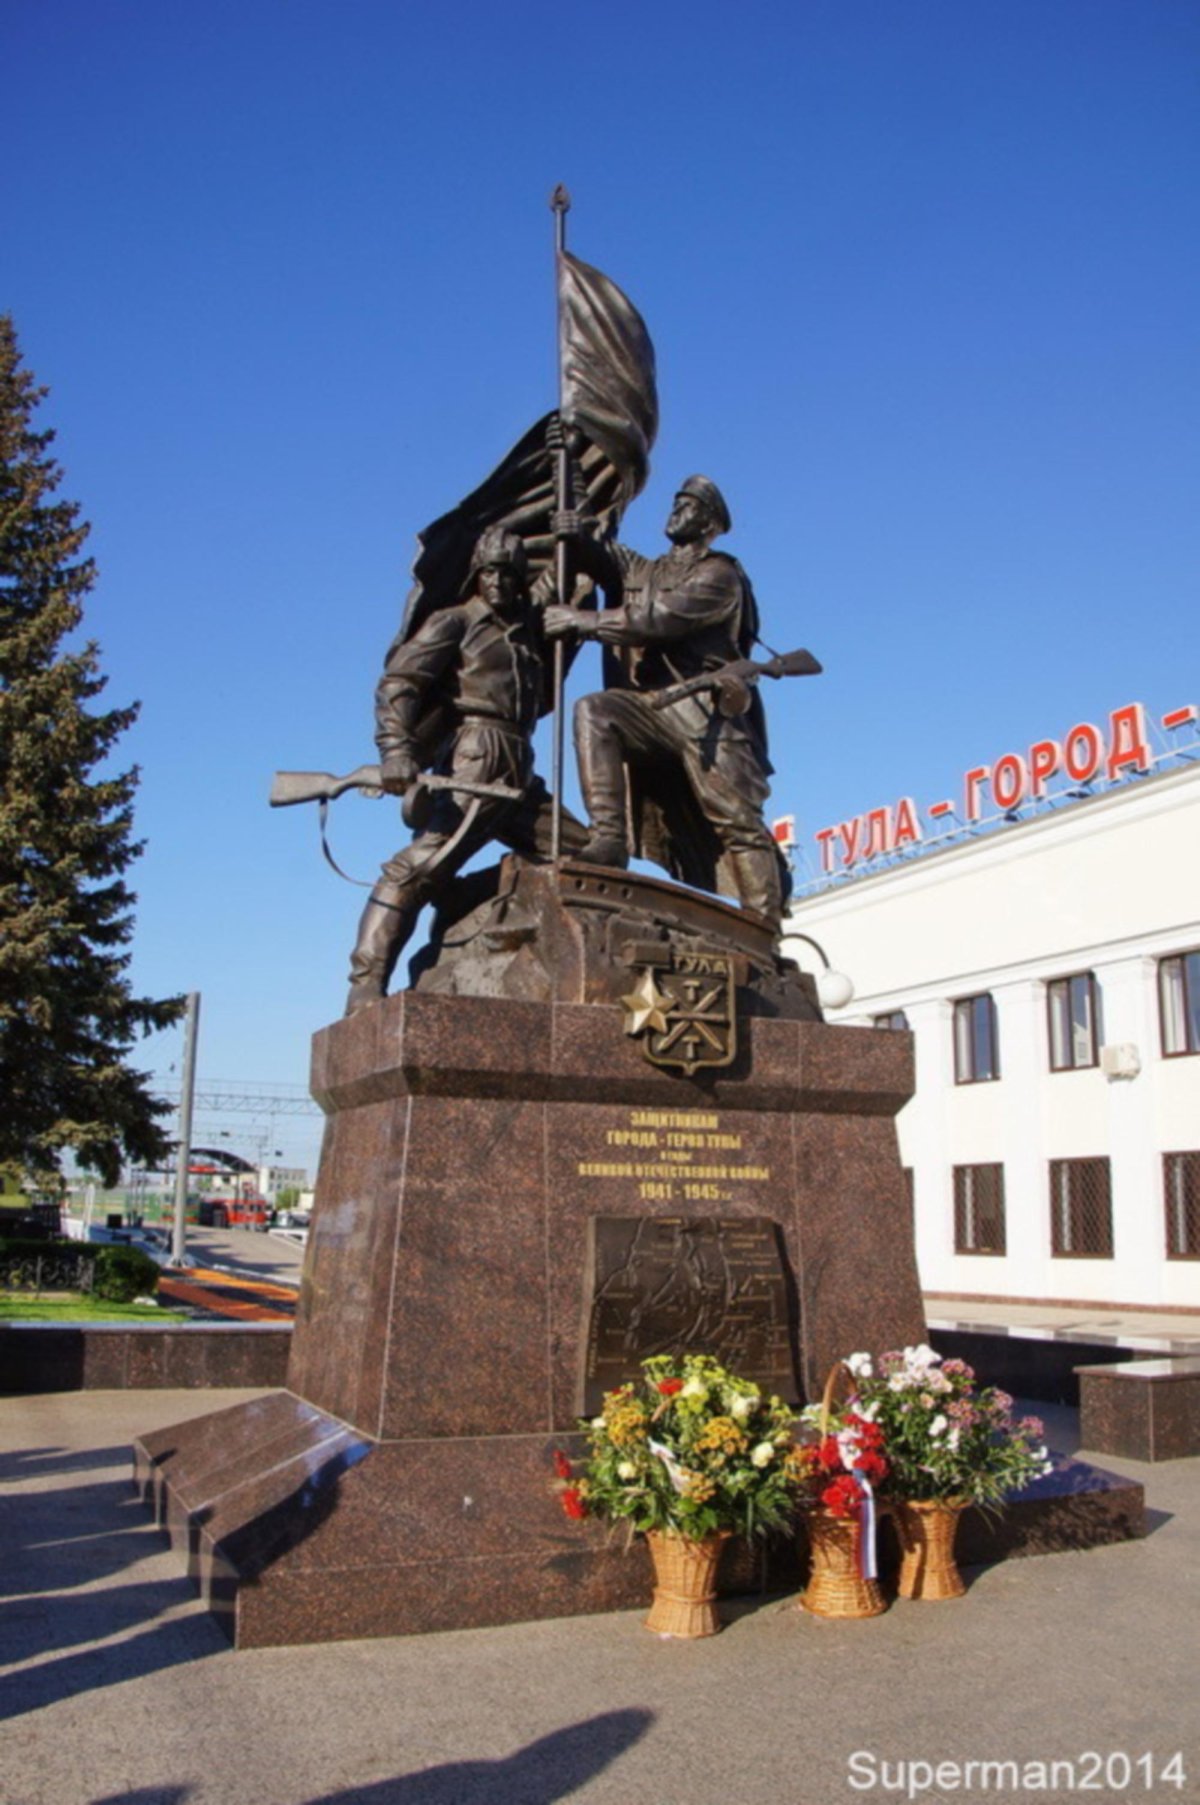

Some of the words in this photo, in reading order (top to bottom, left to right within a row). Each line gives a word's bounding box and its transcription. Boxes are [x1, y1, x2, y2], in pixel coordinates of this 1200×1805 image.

[815, 797, 919, 873] ТУЛА
[964, 702, 1151, 822] ГОРОД
[674, 956, 727, 975] ТУЛА
